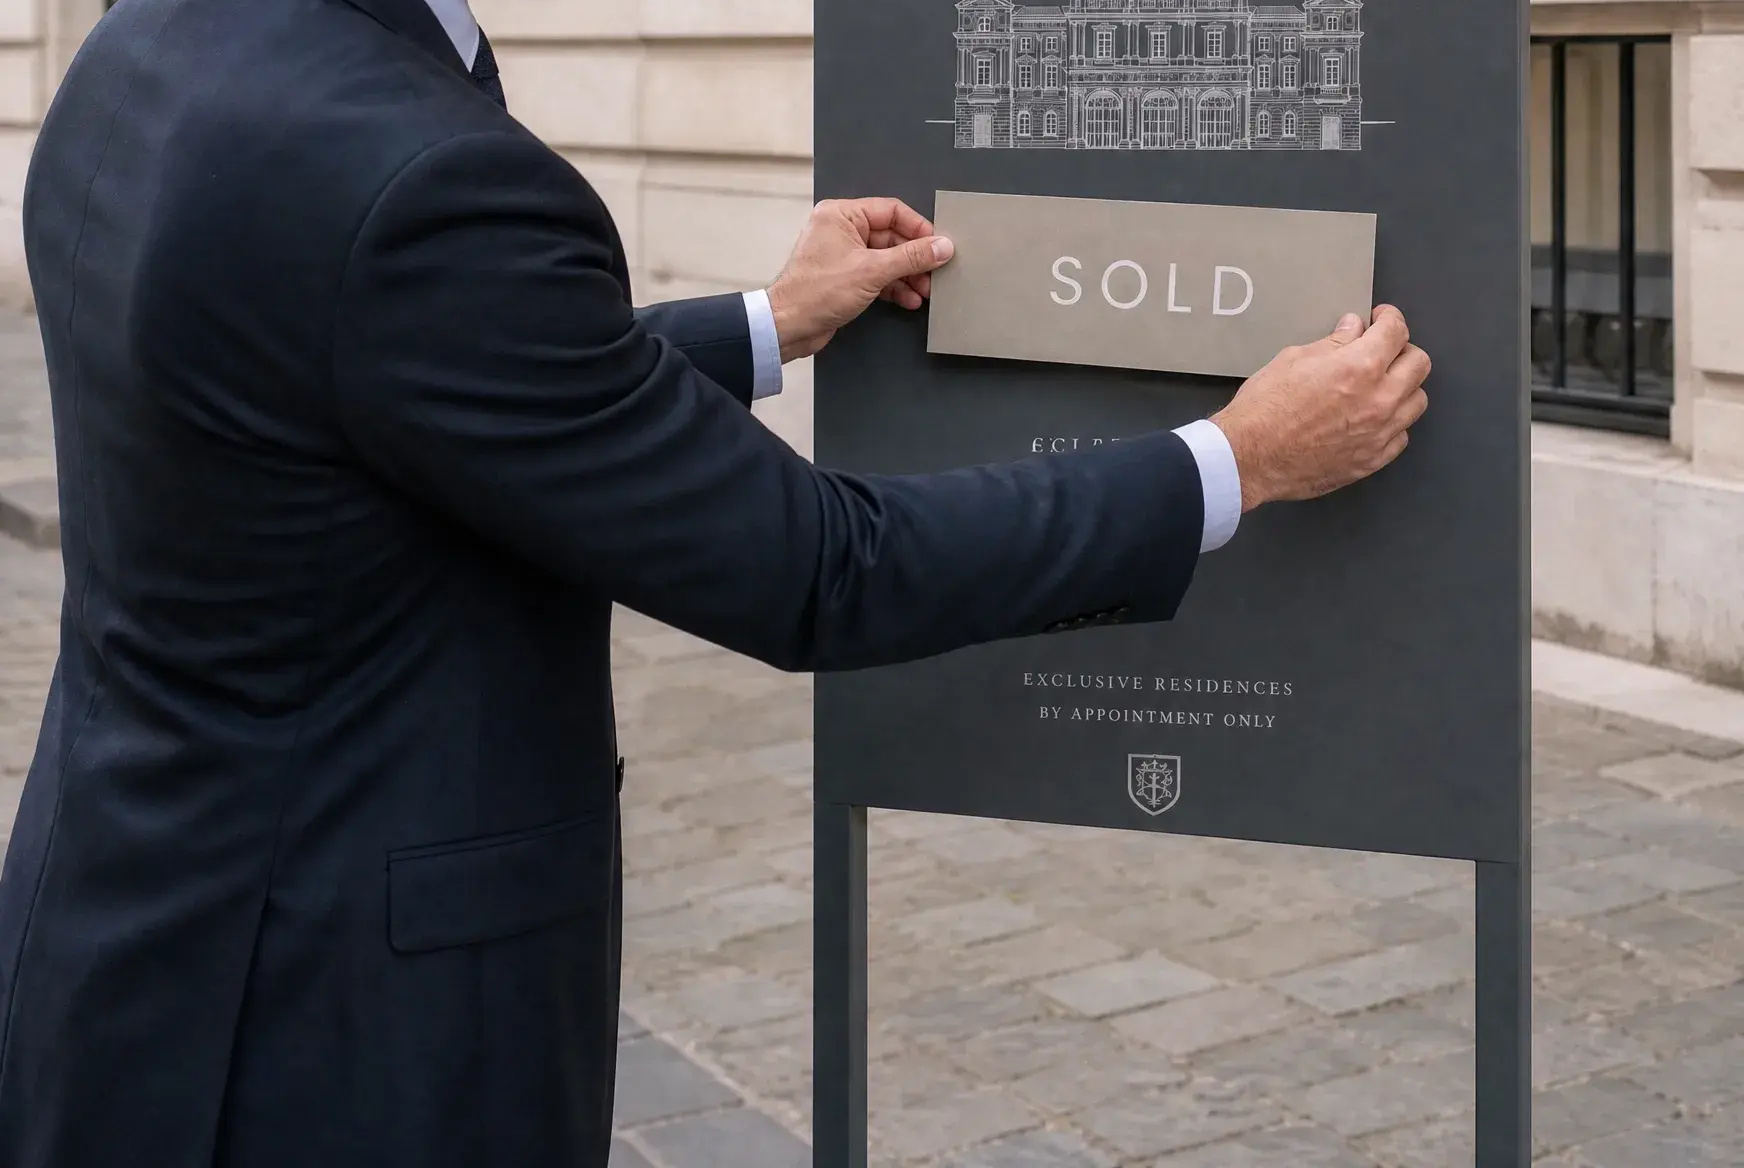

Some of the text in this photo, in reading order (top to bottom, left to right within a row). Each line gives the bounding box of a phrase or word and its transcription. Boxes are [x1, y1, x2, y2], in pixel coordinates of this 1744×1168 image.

[1049, 256, 1254, 316] SOLD
[1023, 672, 1293, 696] EXCLUSIVE RESIDENCES
[1039, 706, 1276, 728] BY APPOINTMENT ONLY
